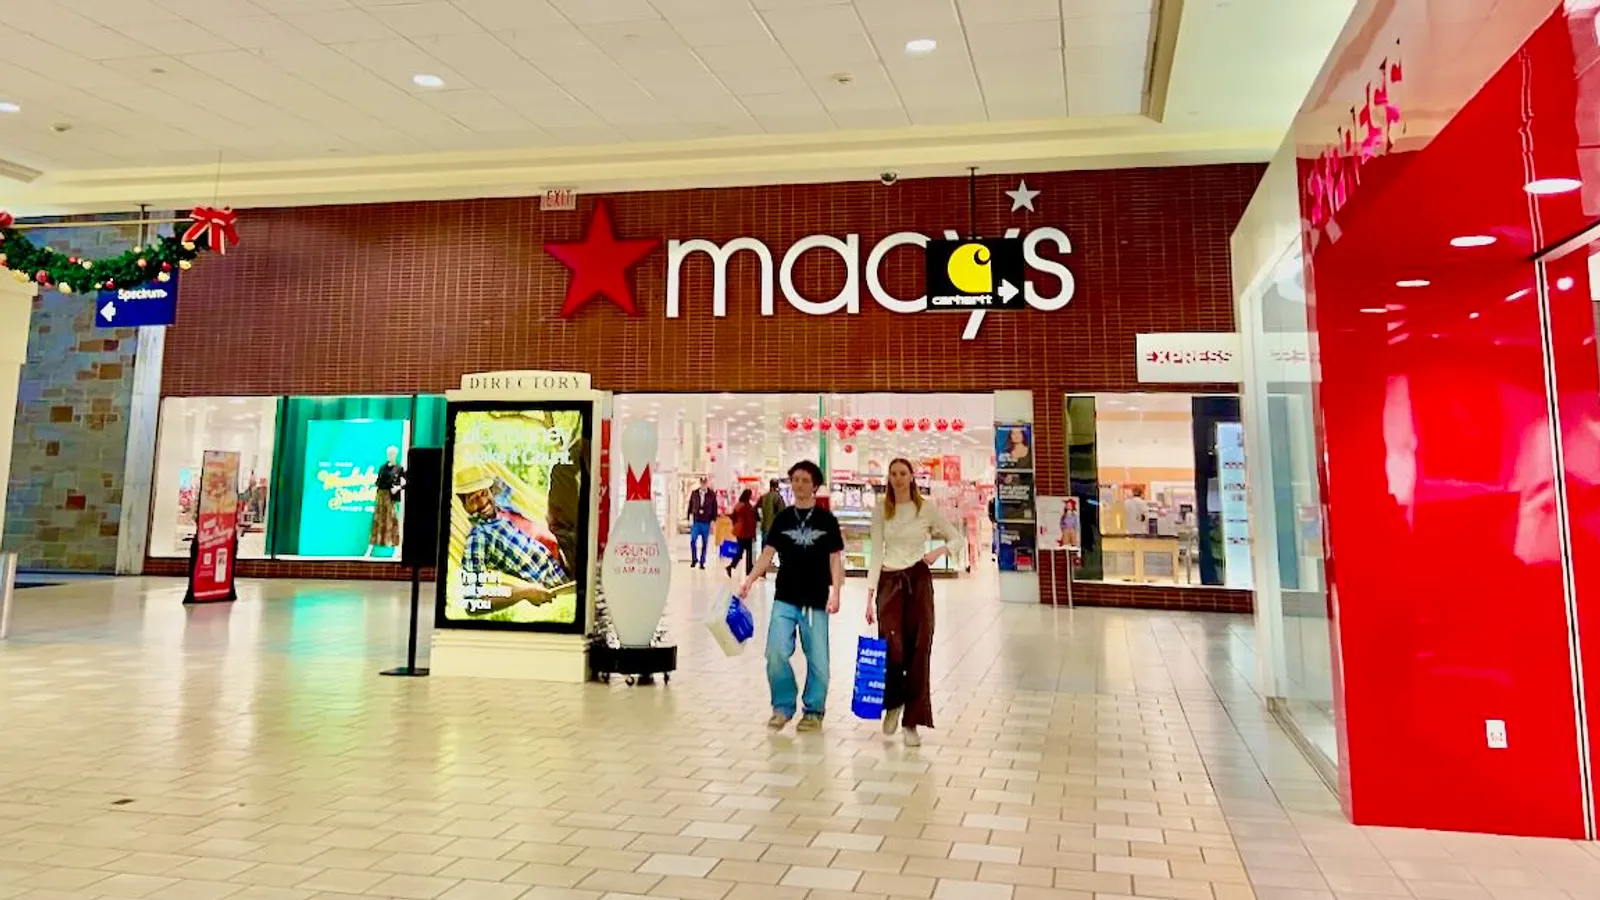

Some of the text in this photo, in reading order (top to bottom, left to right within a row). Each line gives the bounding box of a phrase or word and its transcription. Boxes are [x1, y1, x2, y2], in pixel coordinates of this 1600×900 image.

[546, 190, 573, 207] EXIT
[666, 180, 1075, 340] mac's
[118, 288, 168, 302] Spectrum
[932, 295, 992, 305] carhartt
[1147, 350, 1233, 364] EXPRESS
[469, 375, 582, 390] DIRECTORY
